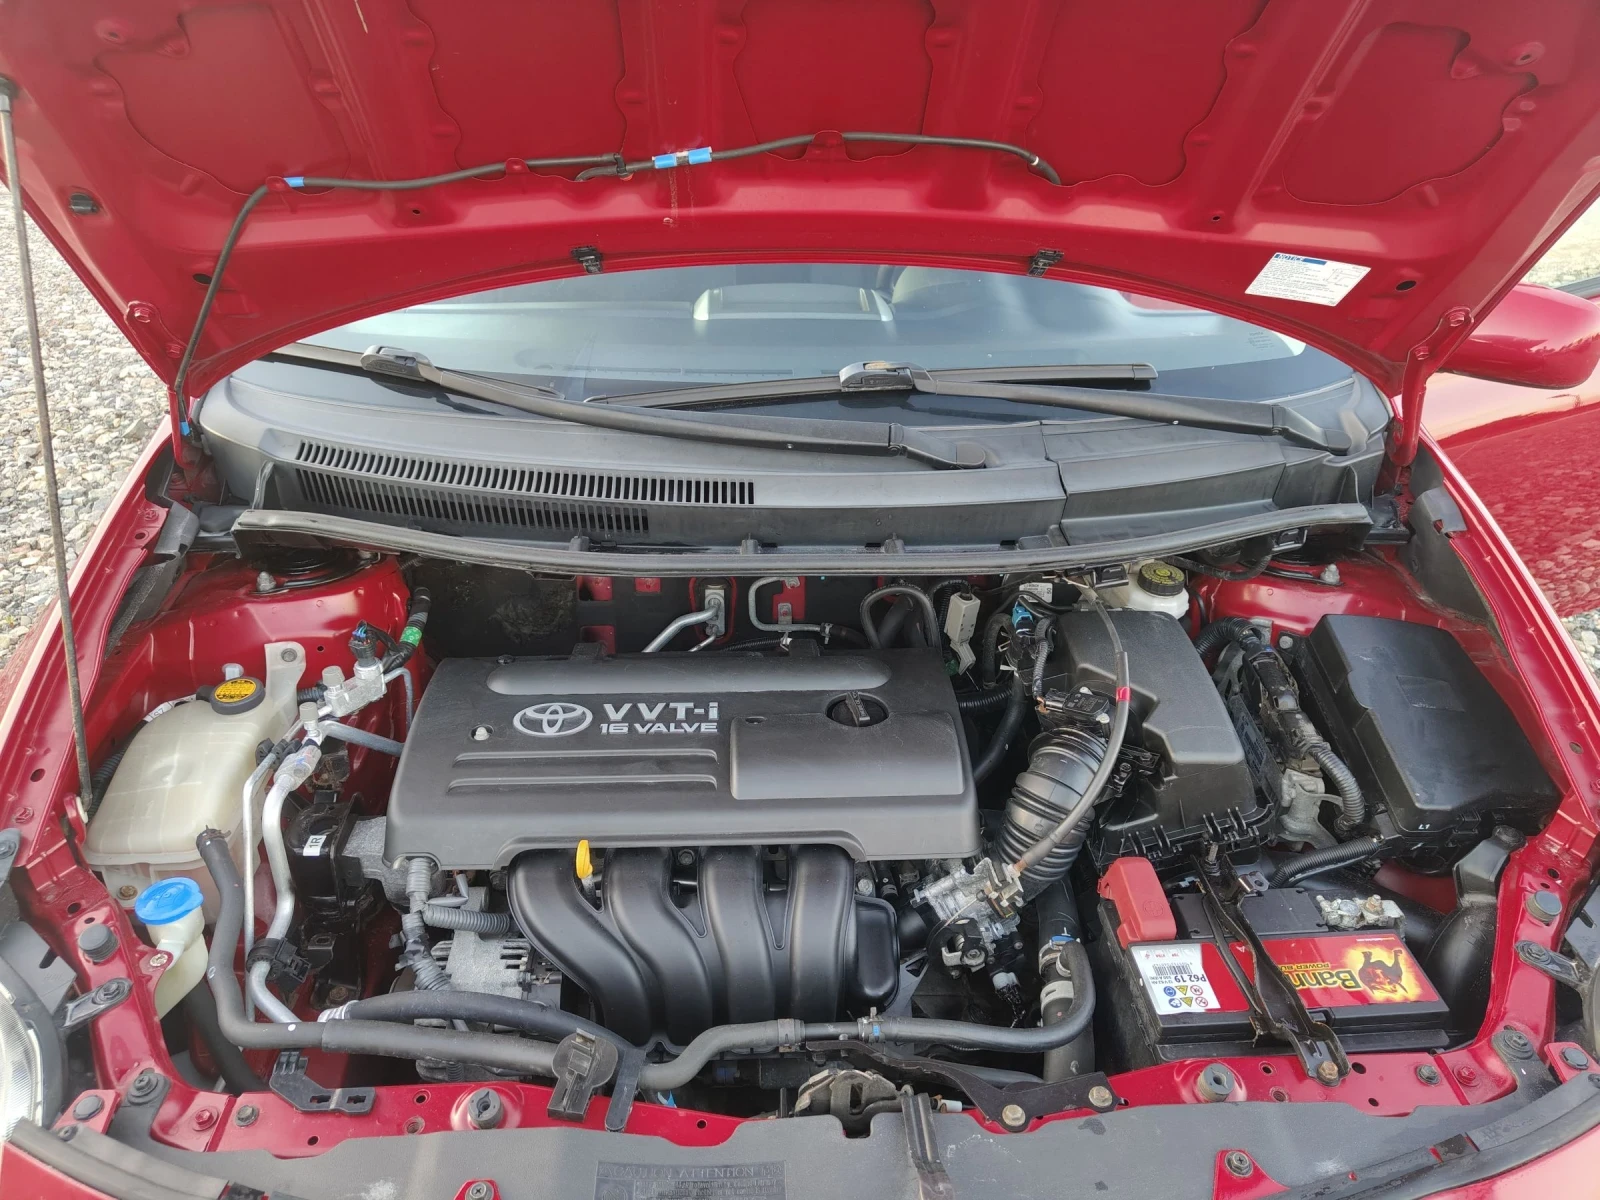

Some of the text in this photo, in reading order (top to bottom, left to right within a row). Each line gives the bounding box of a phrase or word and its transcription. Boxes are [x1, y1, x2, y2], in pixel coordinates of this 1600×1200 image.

[603, 702, 719, 721] VVT-i
[600, 722, 719, 735] 16 VALVE
[1295, 962, 1330, 971] POWER
[1174, 973, 1207, 983] P62 19
[1284, 970, 1362, 990] Bann
[613, 1165, 673, 1178] CAUTION
[678, 1165, 755, 1178] ATTENTION
